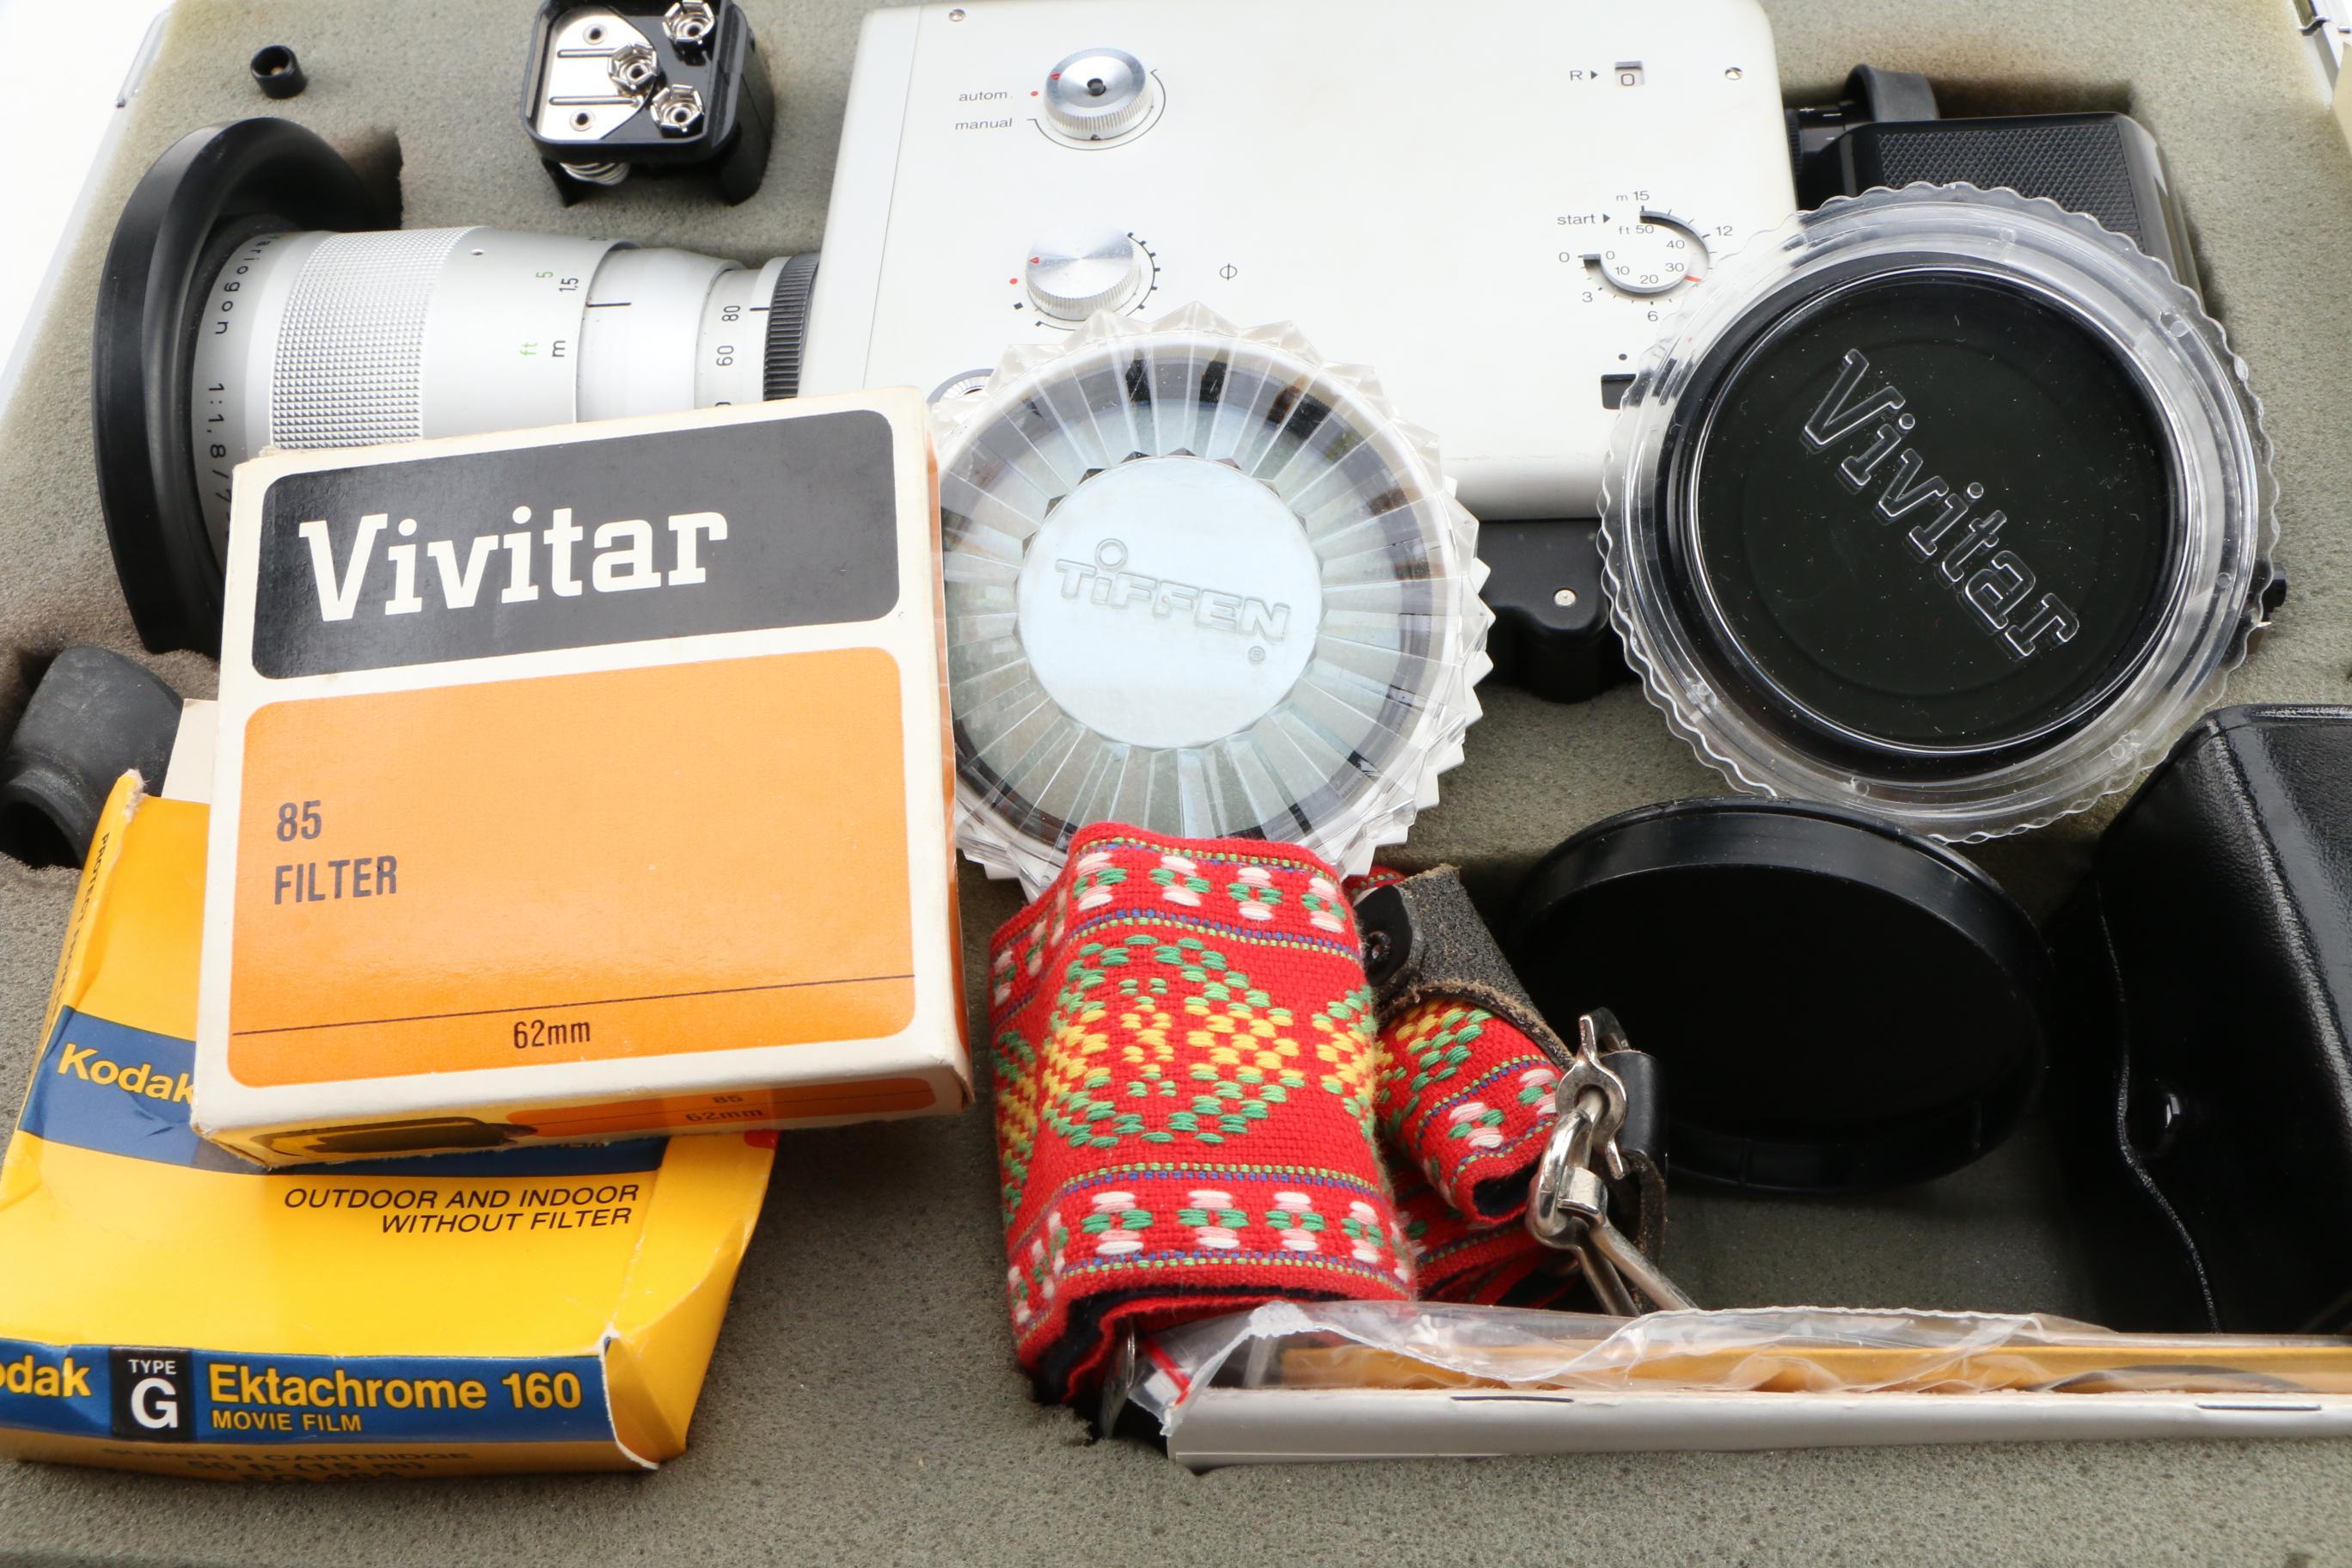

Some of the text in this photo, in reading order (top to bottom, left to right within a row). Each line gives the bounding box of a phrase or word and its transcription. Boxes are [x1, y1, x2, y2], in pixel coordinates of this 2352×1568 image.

[1569, 70, 1583, 81] R
[955, 117, 1013, 131] manual
[1632, 190, 1651, 201] 15
[1556, 214, 1596, 225] start
[1635, 224, 1655, 235] 50
[1715, 225, 1734, 236] 12
[1666, 240, 1686, 249] 40
[1614, 266, 1631, 275] 10
[1664, 262, 1685, 273] 30
[1639, 274, 1659, 285] 20
[1581, 291, 1593, 303] 3
[721, 305, 741, 322] 80
[1647, 310, 1659, 322] 6
[715, 345, 734, 367] 60
[1803, 348, 2080, 658] Vivitar
[298, 505, 728, 622] Vivitar
[276, 799, 322, 842] 85
[273, 854, 398, 905] FILTER
[512, 1019, 591, 1050] 62mm
[57, 1043, 194, 1106] Kodak
[684, 1106, 764, 1123] 62mm
[284, 1183, 640, 1210] OUTDOOR AND INDOOR
[382, 1206, 633, 1234] WITHOUT FILTER
[128, 1358, 177, 1375] TYPE
[0, 1354, 92, 1398] dak
[207, 1362, 584, 1410] Ektachrome 160
[131, 1377, 179, 1430] G
[211, 1410, 363, 1432] MOVIE FILM
